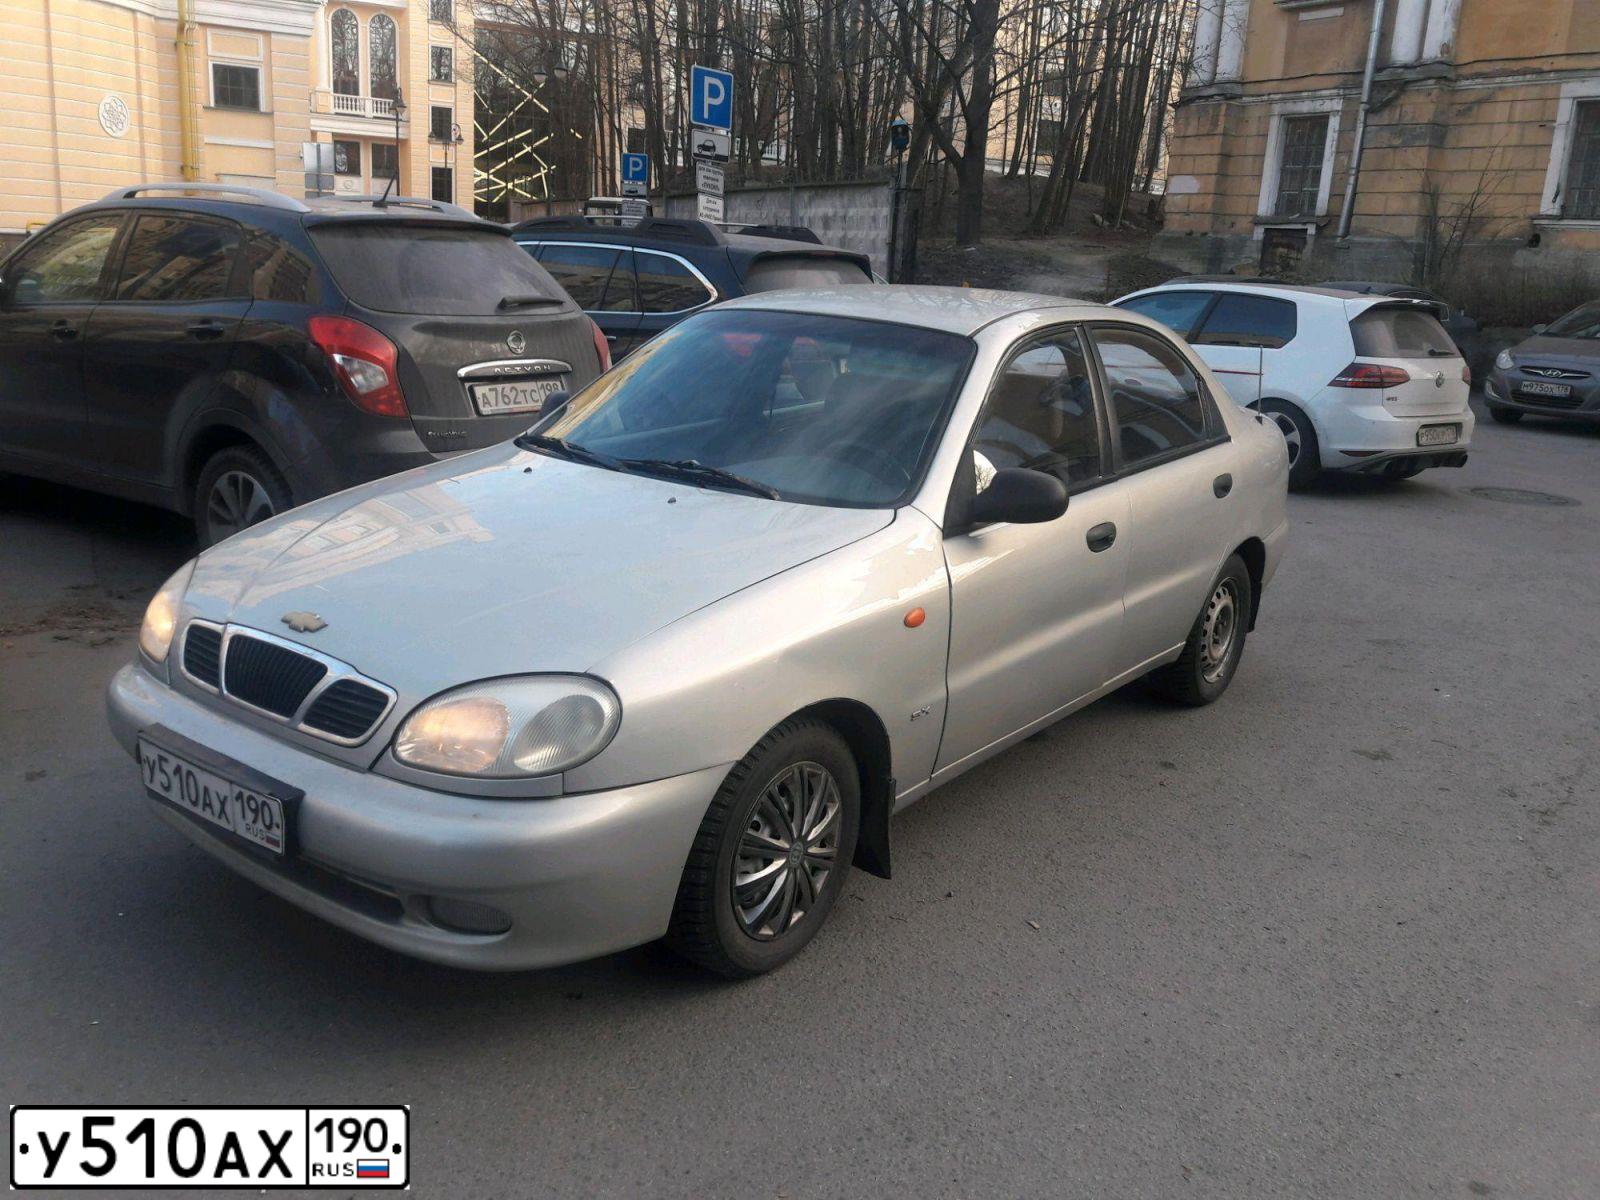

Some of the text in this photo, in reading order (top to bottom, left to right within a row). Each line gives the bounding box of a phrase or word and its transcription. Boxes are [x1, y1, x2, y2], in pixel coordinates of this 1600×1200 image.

[704, 75, 725, 120] P
[629, 157, 643, 179] P
[245, 822, 266, 841] RUS
